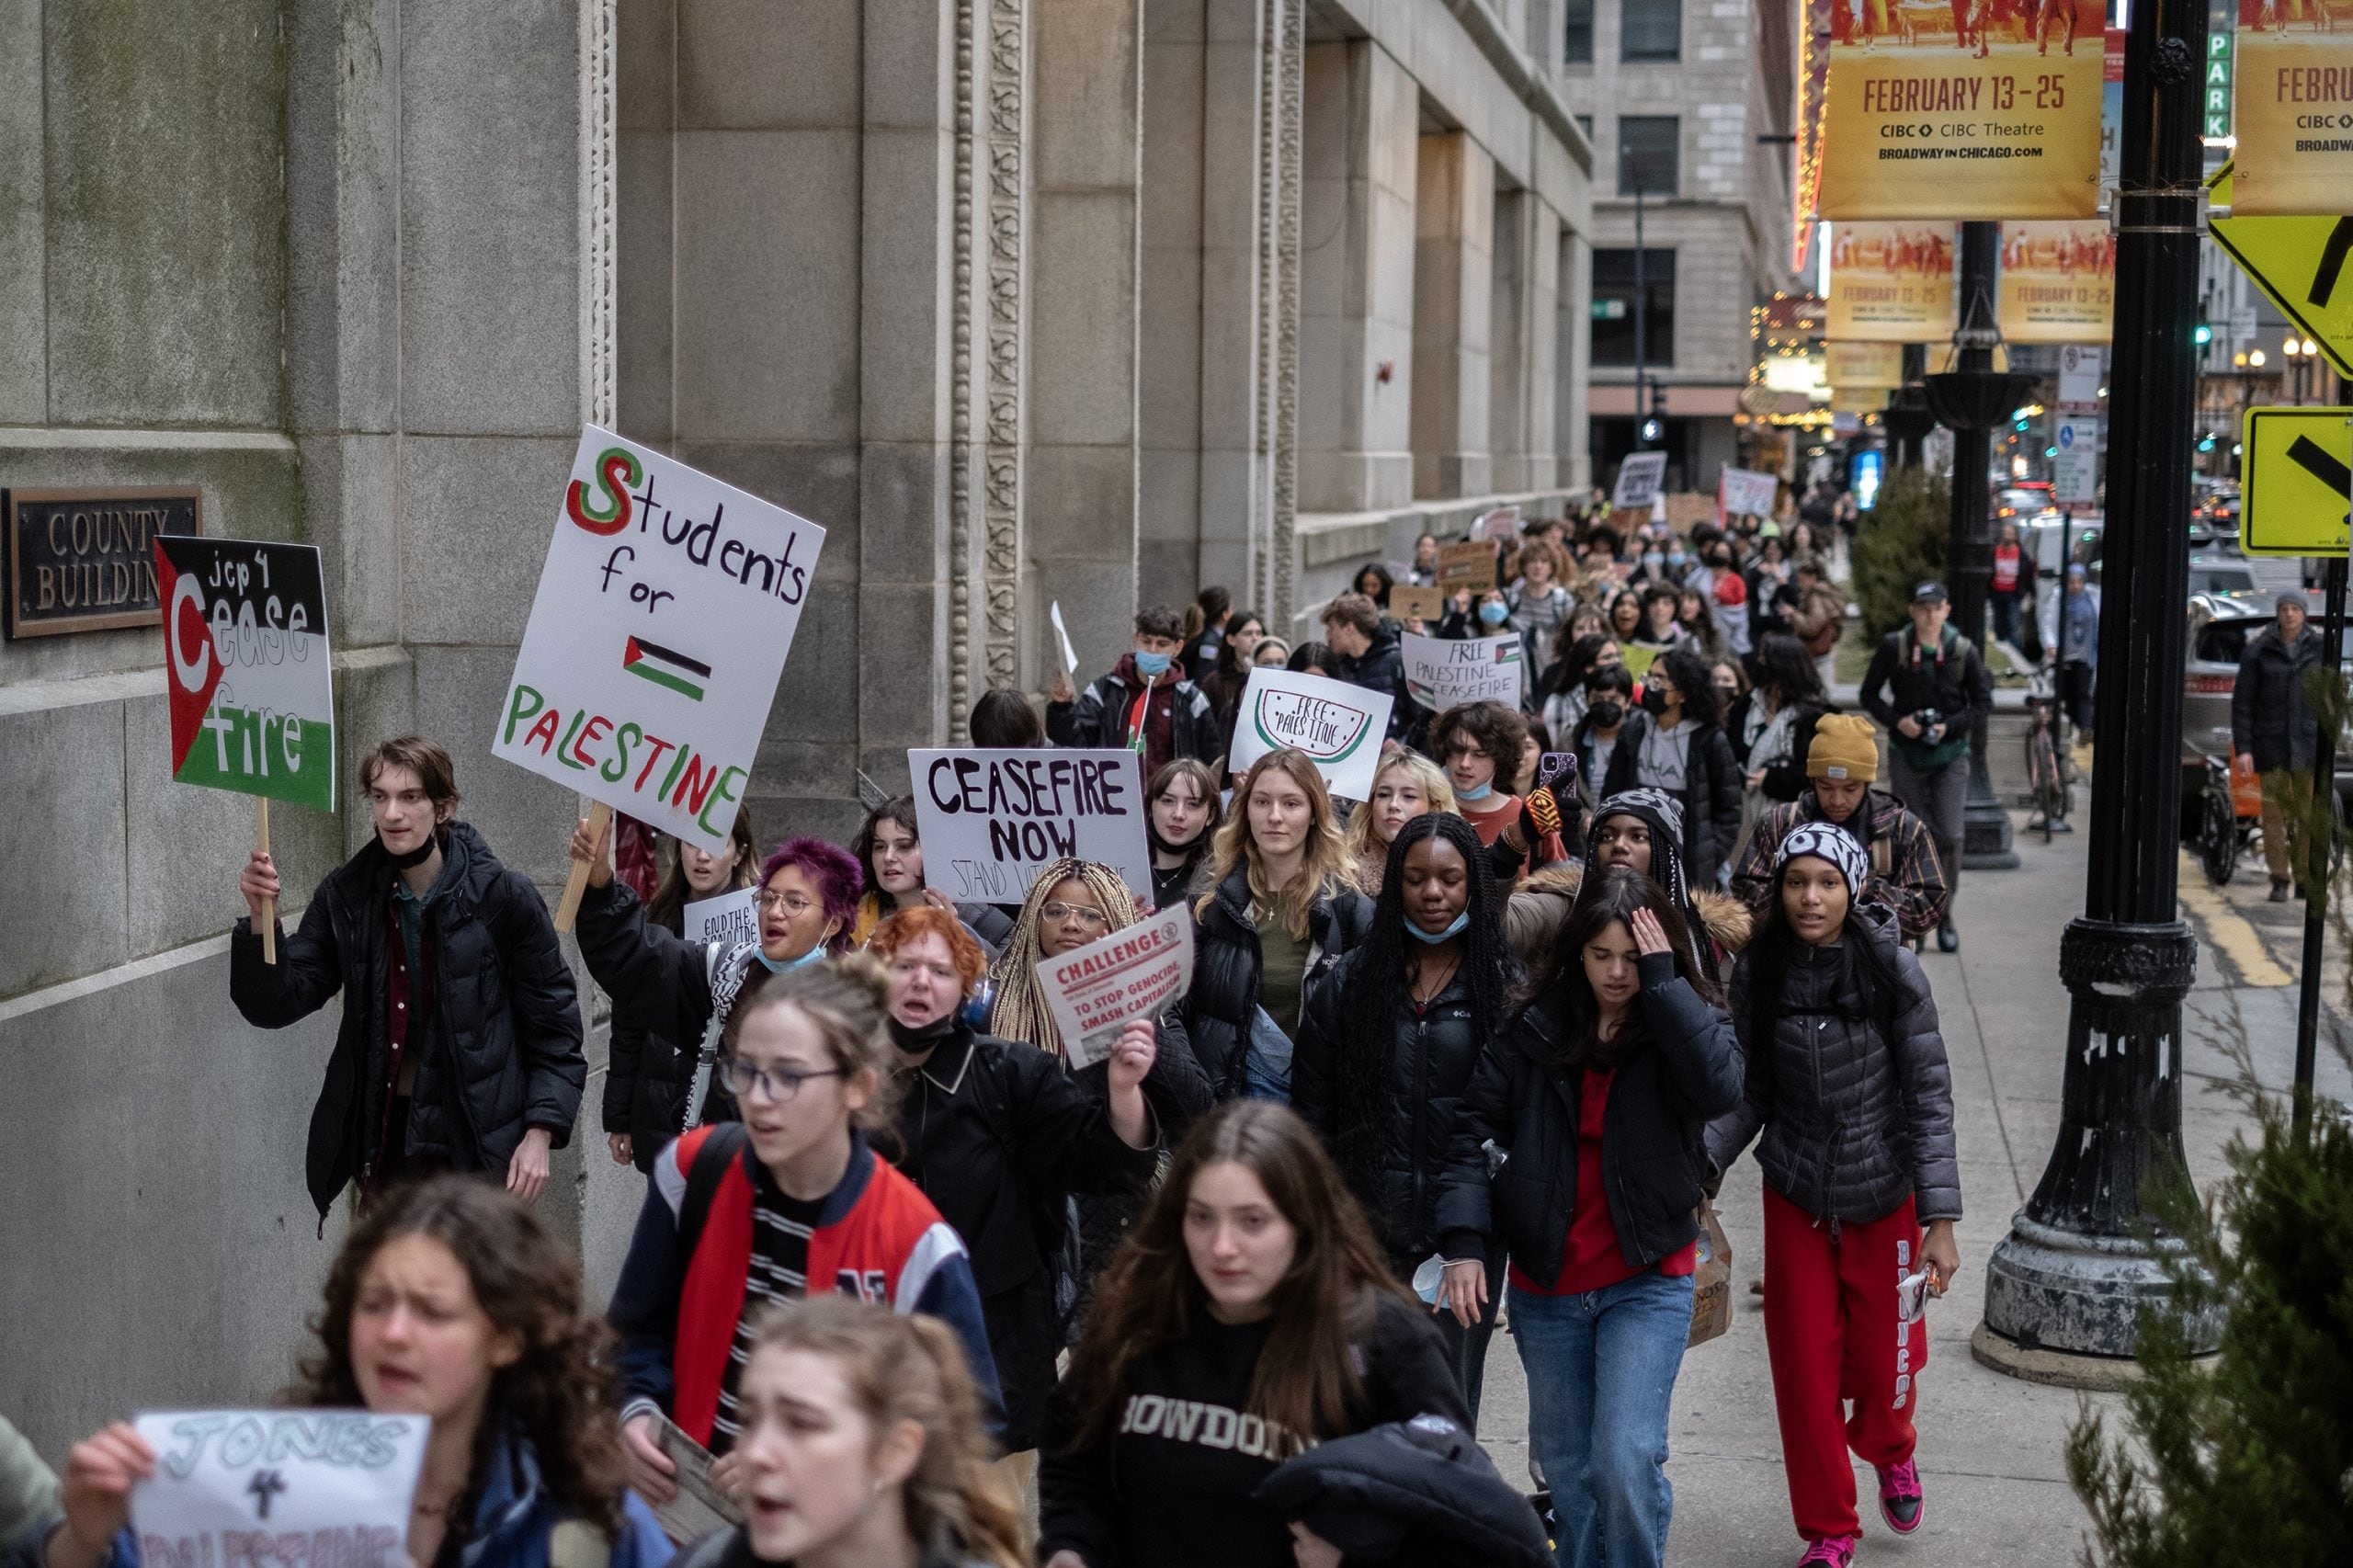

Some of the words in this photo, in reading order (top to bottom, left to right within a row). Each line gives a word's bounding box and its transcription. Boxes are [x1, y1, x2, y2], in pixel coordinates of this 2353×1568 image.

[1864, 76, 1983, 112] FEBRUARY
[2208, 36, 2225, 135] PARK
[2277, 67, 2353, 102] FEBRU
[1881, 124, 1915, 137] CIBC
[1940, 123, 1976, 137] CIBC
[1984, 122, 2044, 136] Theatre
[2296, 115, 2335, 129] CIBC
[1844, 286, 1897, 302] FEBRUARY
[2018, 286, 2073, 302] FEBRUARY
[50, 509, 169, 556] COUNTY
[566, 447, 806, 606] Students
[37, 560, 161, 610] BUILDIN
[600, 545, 675, 614] for
[170, 573, 309, 692] Cease
[1449, 642, 1486, 664] FREE
[1415, 661, 1496, 683] PALESTINE
[1433, 676, 1512, 699] CEASEFIRE
[202, 681, 301, 778] fire
[1297, 697, 1331, 722] FREE
[503, 684, 748, 838] PALESTINE
[928, 756, 1128, 817] CEASEFIRE
[989, 818, 1076, 862] NOW
[950, 859, 1007, 898] STAND
[1014, 864, 1044, 898] WIT
[704, 914, 728, 937] END
[728, 906, 751, 929] THE
[1056, 929, 1162, 985] CHALLENGE
[1074, 1001, 1092, 1017] TO
[1094, 989, 1124, 1010] STOP
[1080, 1006, 1124, 1031] SMASH
[1127, 972, 1181, 1012] CAPITALISM
[165, 1415, 411, 1481] JONES
[1120, 1393, 1318, 1463] OWDOI
